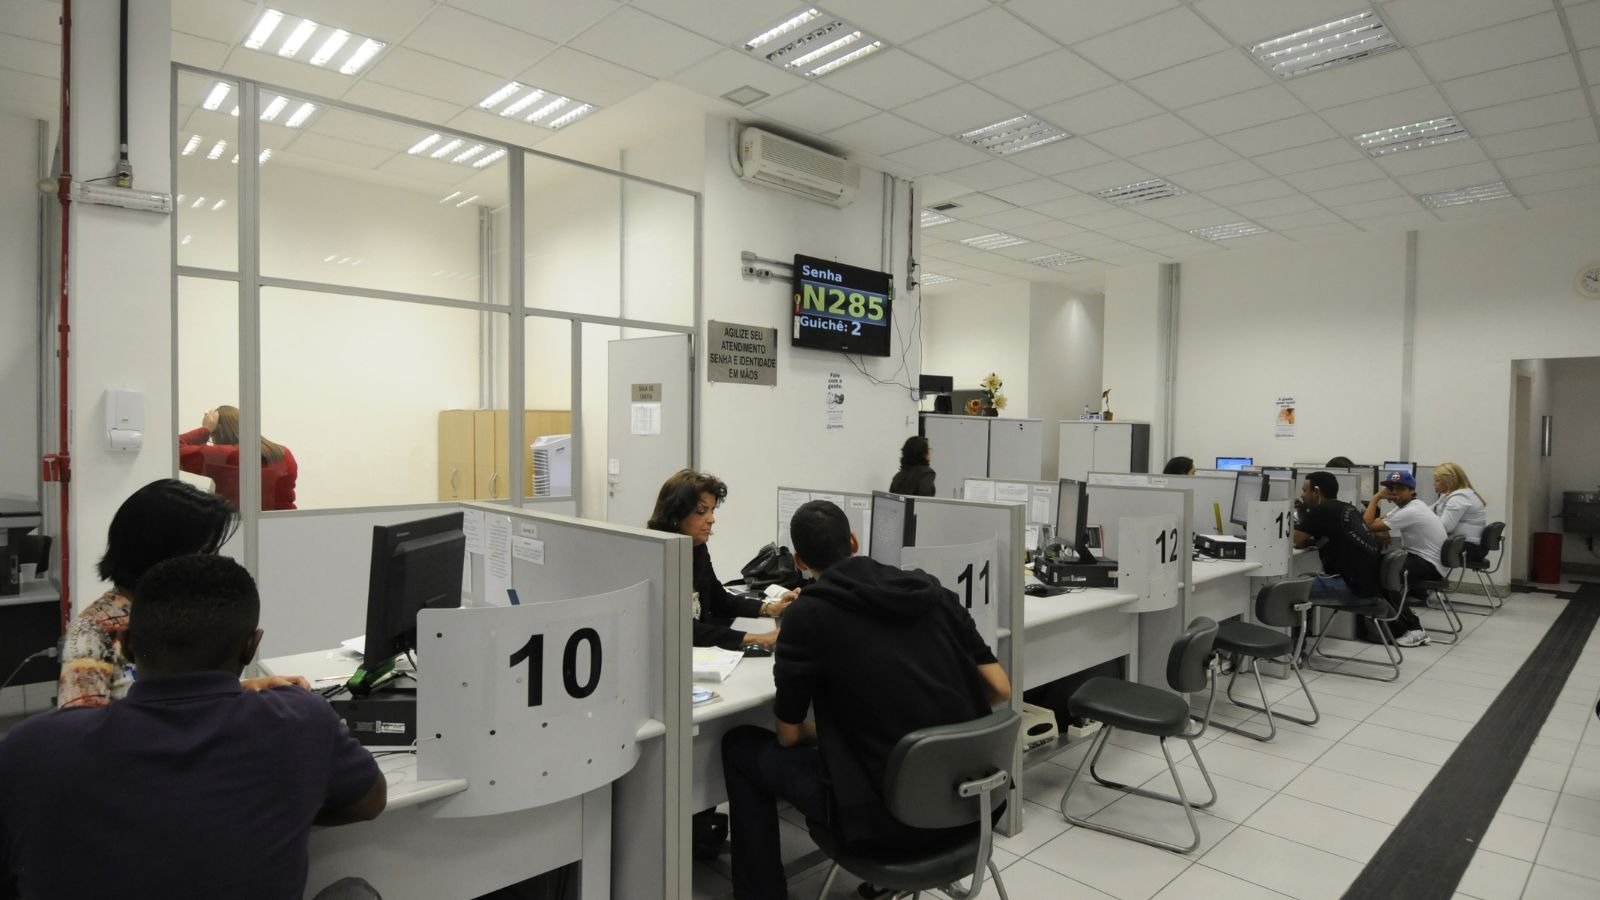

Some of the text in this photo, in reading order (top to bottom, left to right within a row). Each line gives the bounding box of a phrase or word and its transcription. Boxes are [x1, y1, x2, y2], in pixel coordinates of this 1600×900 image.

[802, 264, 843, 282] Senha
[803, 284, 884, 321] N285
[724, 327, 763, 341] AGILIZE SEU
[800, 316, 861, 336] Guichê: 2
[721, 340, 766, 354] ATENDIMENTO
[710, 353, 776, 368] SENHA E IDENTIDADE
[728, 367, 759, 380] EM MÃOS
[1275, 511, 1291, 538] 13
[1155, 528, 1177, 564] 12
[957, 560, 989, 608] 11
[509, 627, 602, 707] 10
